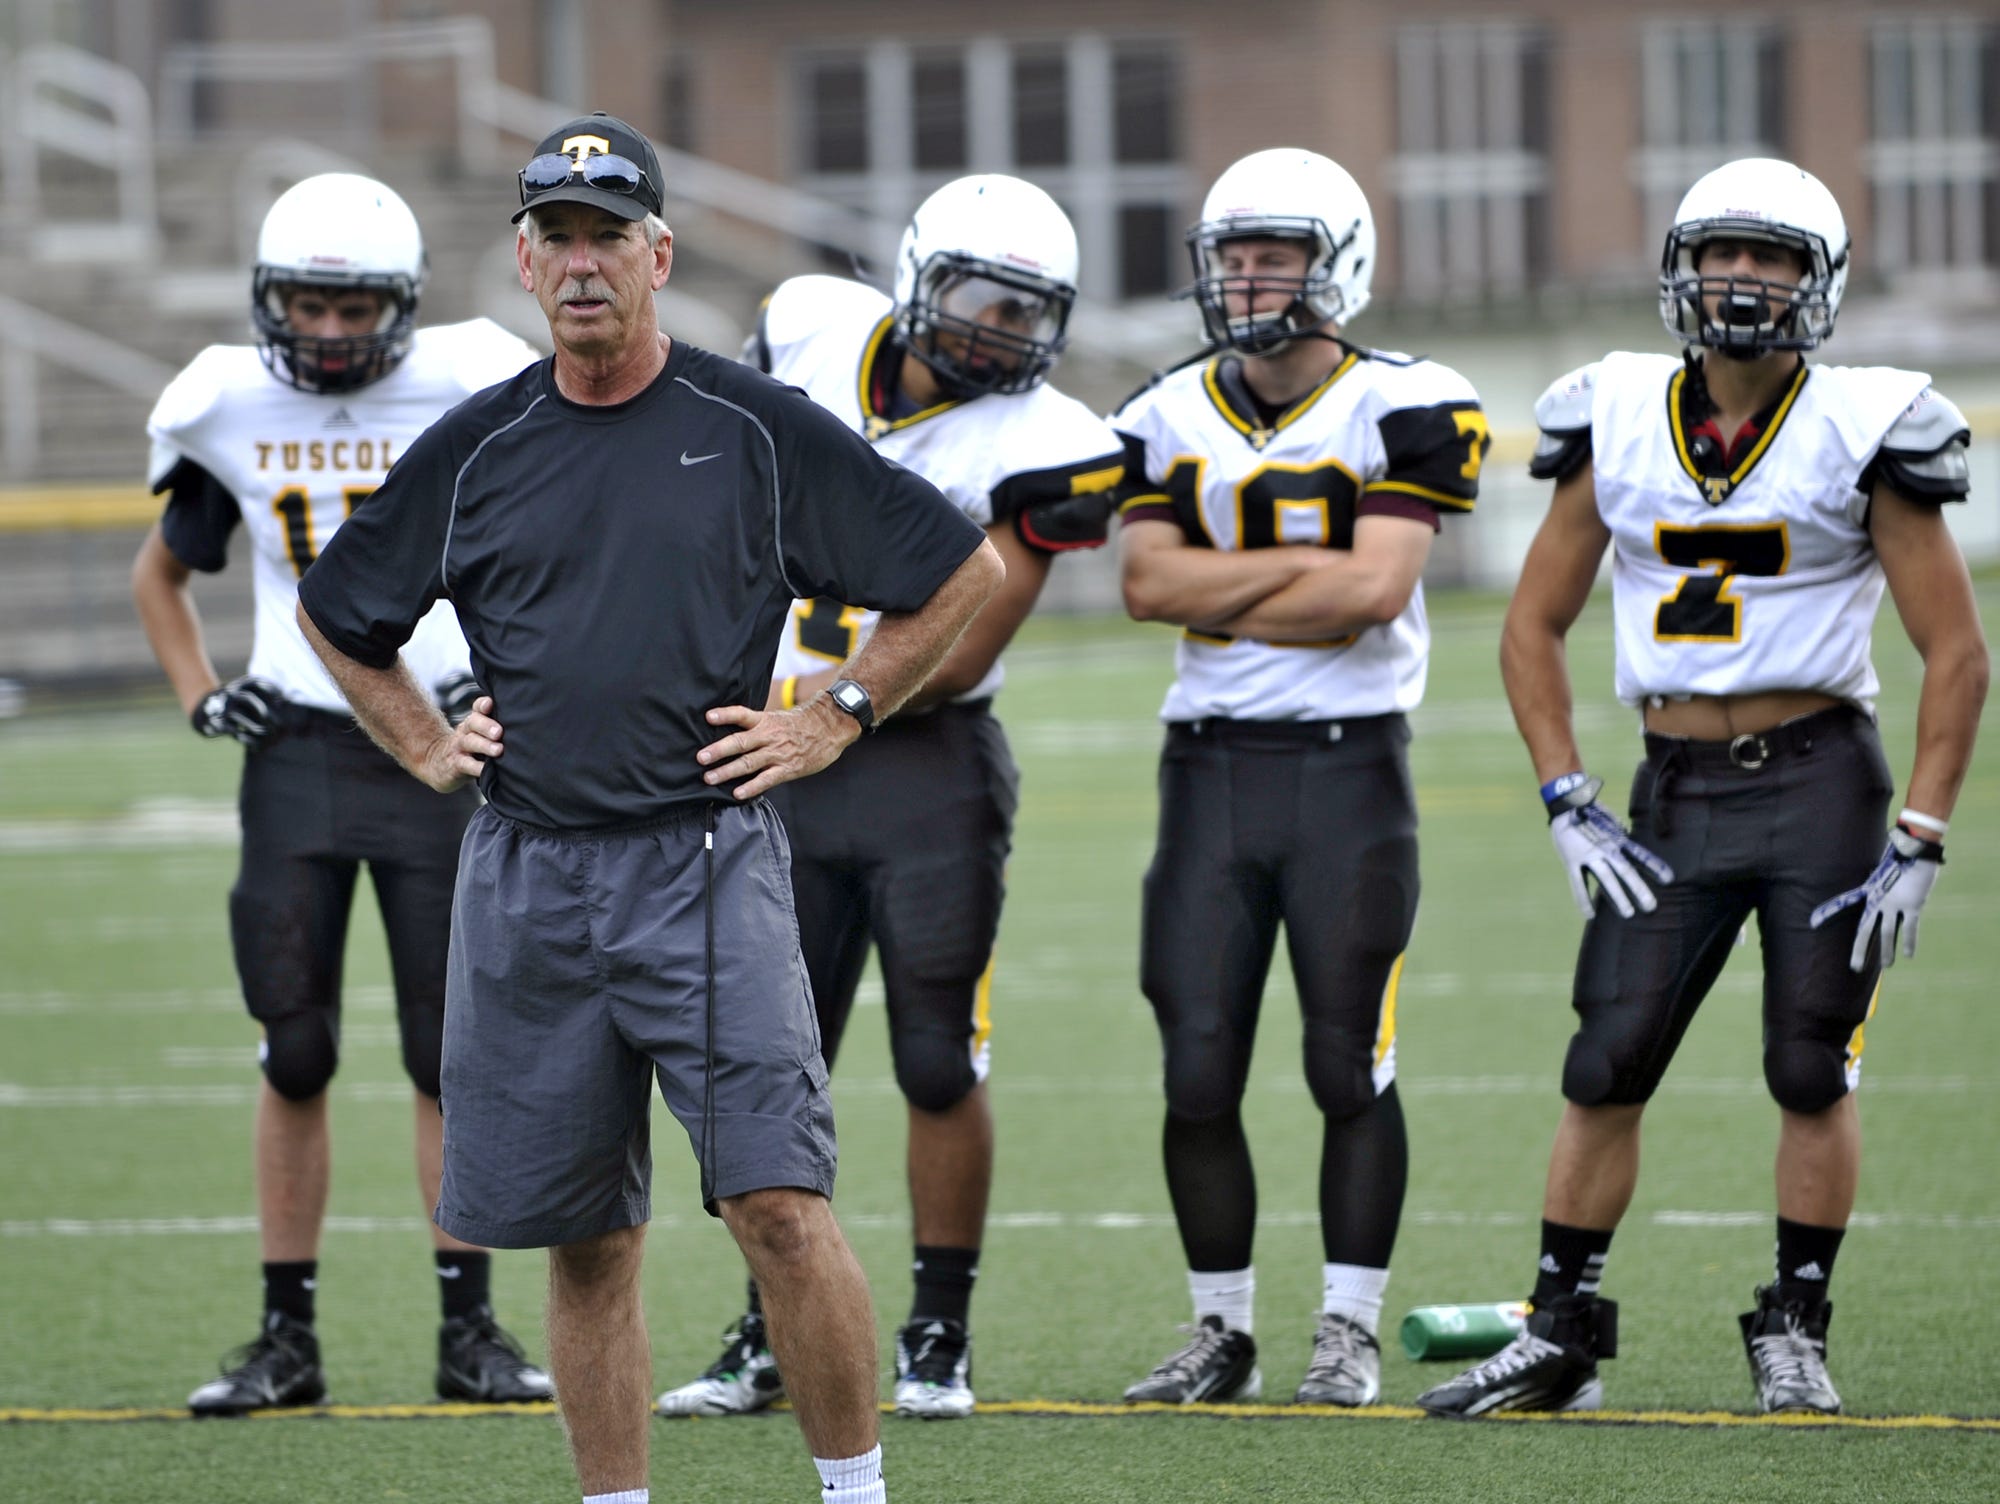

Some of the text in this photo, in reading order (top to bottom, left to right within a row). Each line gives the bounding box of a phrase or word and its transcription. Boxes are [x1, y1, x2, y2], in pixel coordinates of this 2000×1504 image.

[560, 134, 610, 172] T
[255, 438, 396, 472] TUSCOL
[1705, 477, 1729, 503] T
[272, 484, 380, 578] 1
[1653, 519, 1791, 643] 7
